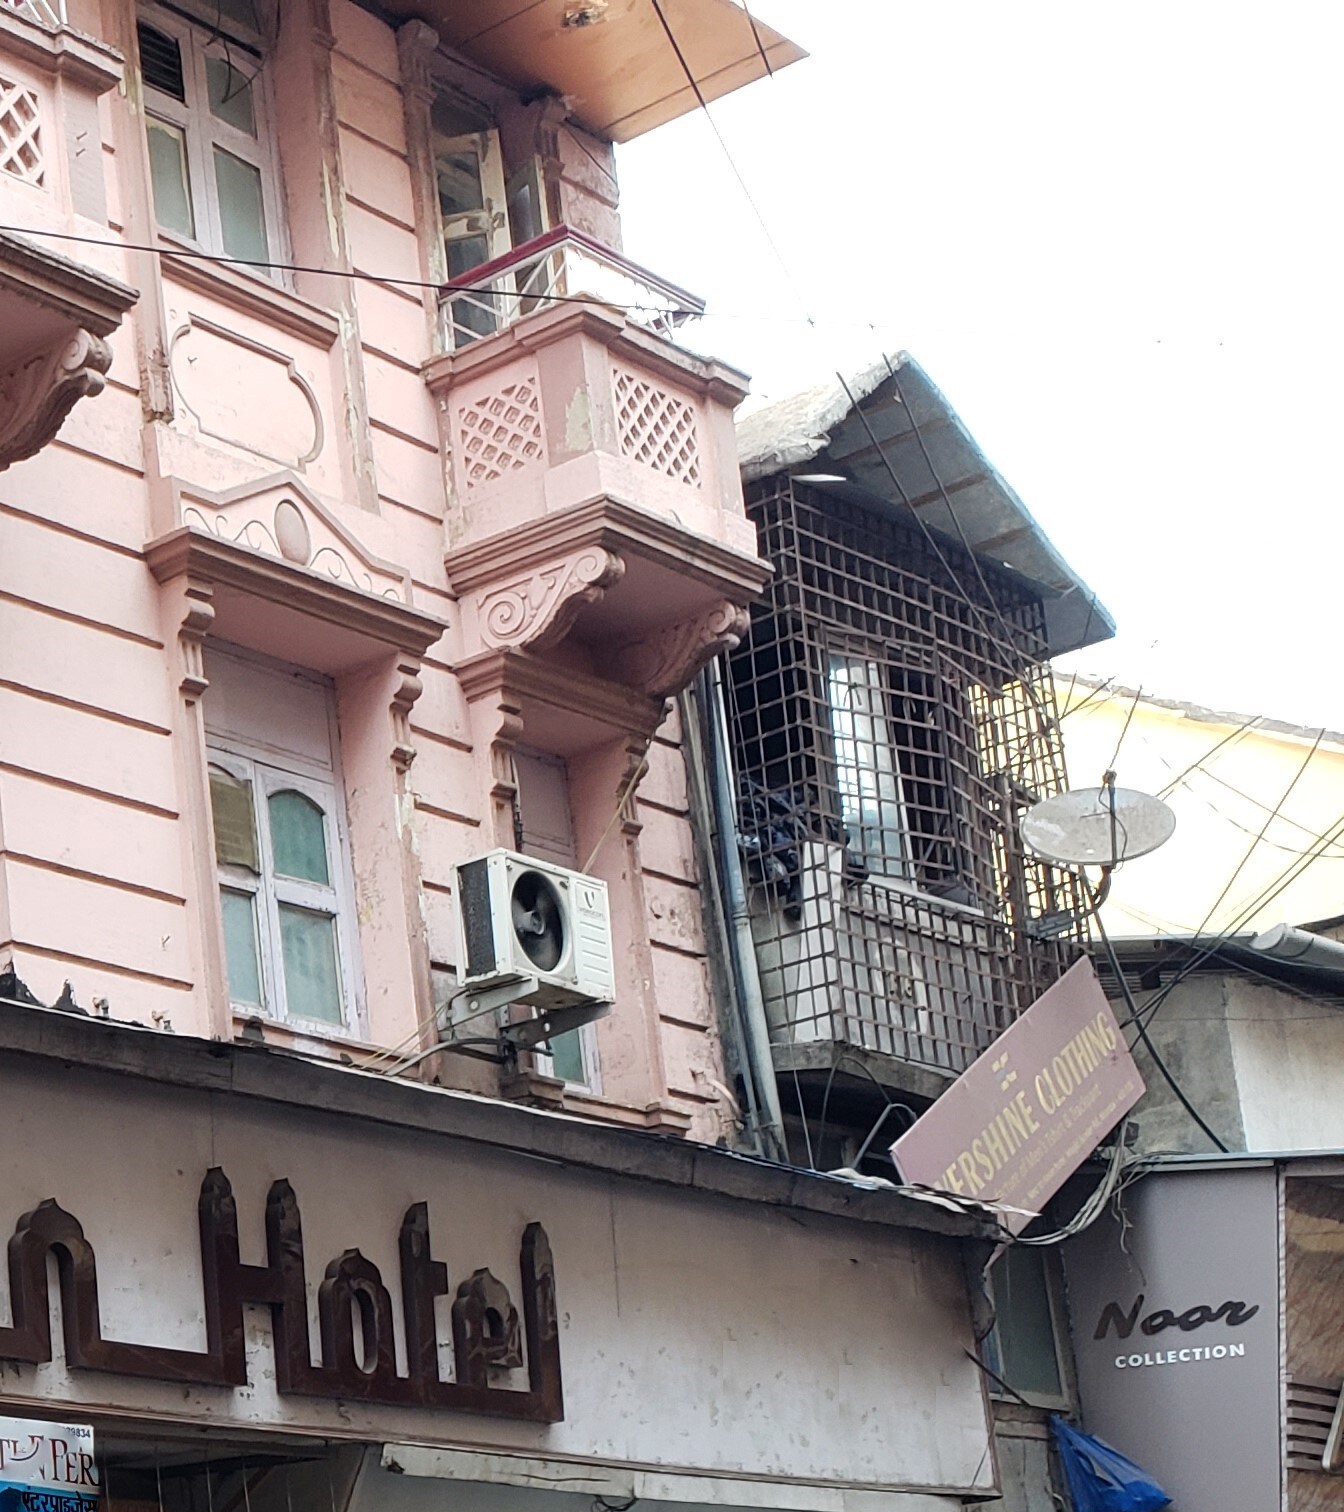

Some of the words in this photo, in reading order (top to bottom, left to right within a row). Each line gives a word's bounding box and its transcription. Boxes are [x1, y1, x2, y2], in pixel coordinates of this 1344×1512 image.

[1035, 1012, 1116, 1115] CLOTHING
[199, 1166, 565, 1423] Hotel
[1093, 1294, 1259, 1340] Noor
[1114, 1343, 1246, 1369] COLLECTION
